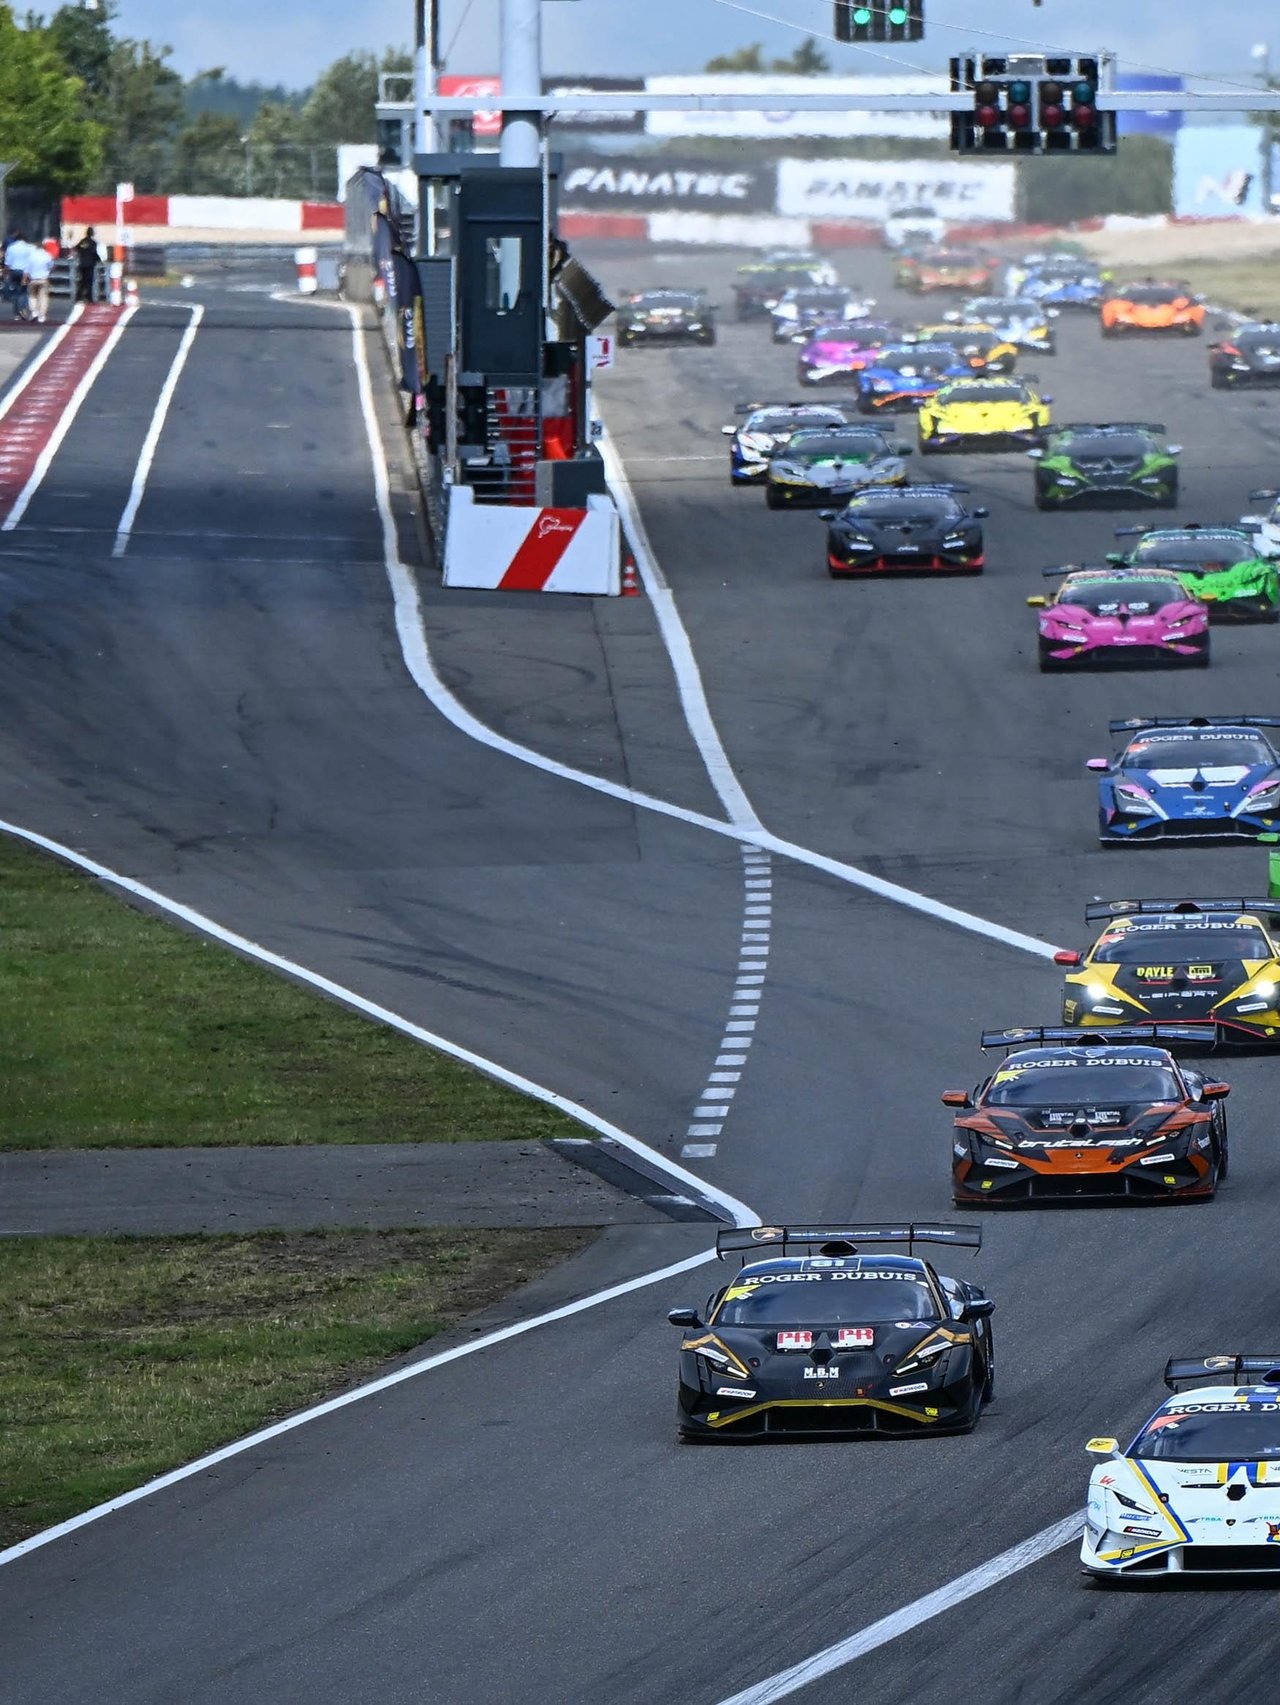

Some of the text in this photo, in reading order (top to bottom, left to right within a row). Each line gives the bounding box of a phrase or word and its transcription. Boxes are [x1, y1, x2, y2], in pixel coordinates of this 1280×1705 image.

[564, 167, 753, 198] FANATEC
[1114, 922, 1253, 933] ROGER DUBUIS
[1008, 1058, 1163, 1071] ROGER DUBUIS
[744, 1271, 917, 1285] ROGER DUBUIS
[778, 1331, 811, 1344] PR
[839, 1329, 873, 1341] PR
[1167, 1403, 1251, 1415] ROGER
